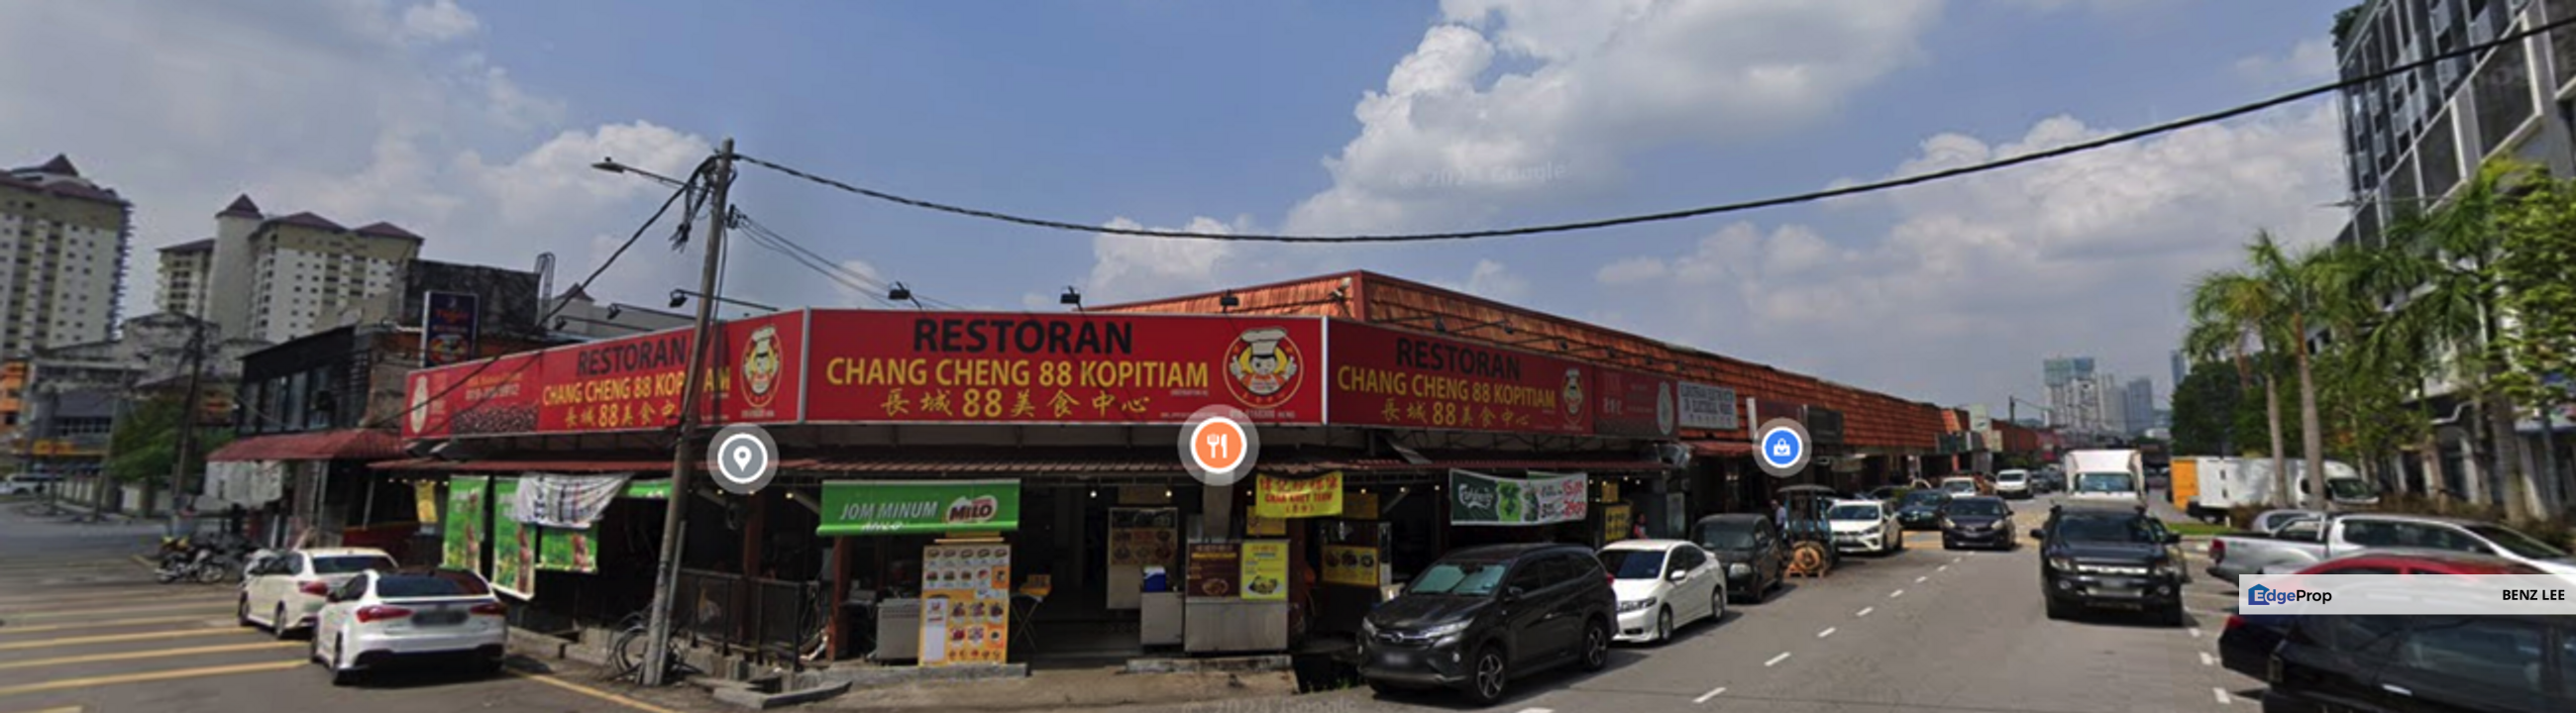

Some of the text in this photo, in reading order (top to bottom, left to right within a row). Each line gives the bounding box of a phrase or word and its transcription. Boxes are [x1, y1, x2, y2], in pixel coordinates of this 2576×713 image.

[912, 318, 1133, 355] RESTORAN
[576, 337, 687, 376] RESTORAN
[826, 357, 1209, 388] CHANG CHENG 88 KOPITIAM
[1395, 338, 1521, 380] RESTORAN
[542, 382, 583, 407] CHANG
[585, 376, 631, 403] CHENG
[633, 376, 652, 399] 88
[1337, 365, 1408, 394] CHANG
[1411, 372, 1468, 400] CHENG
[1471, 382, 1493, 402] 88
[1493, 383, 1556, 409] KOPITIAM
[840, 500, 938, 520] JOM MINUM
[948, 502, 993, 521] MILO
